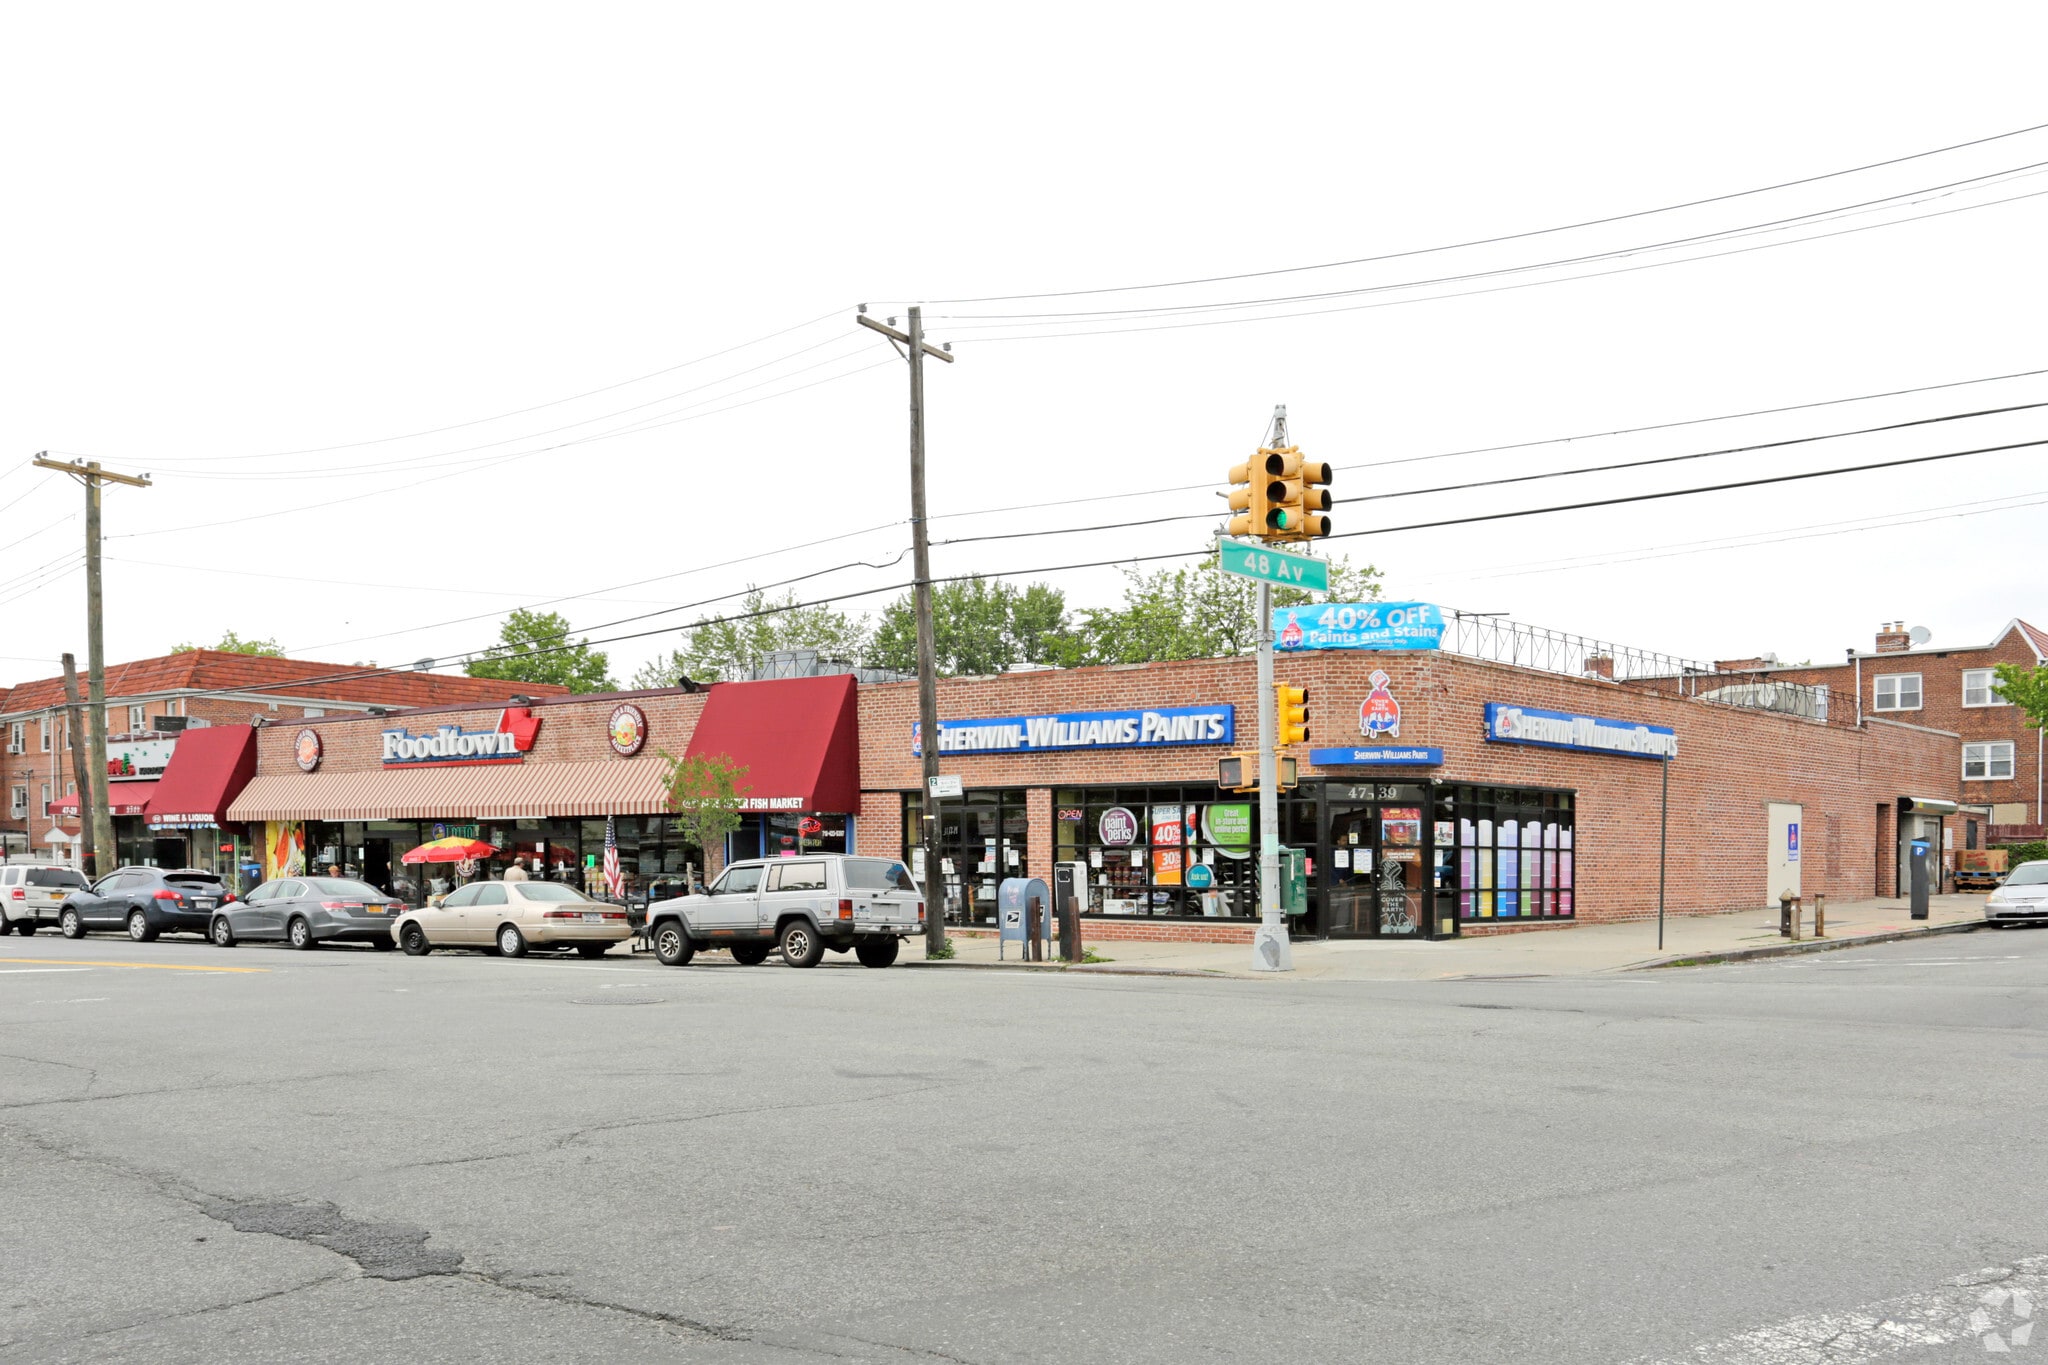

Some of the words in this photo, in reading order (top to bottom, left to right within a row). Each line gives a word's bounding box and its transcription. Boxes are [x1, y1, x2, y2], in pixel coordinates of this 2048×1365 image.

[1244, 552, 1270, 575] 48
[1277, 559, 1303, 581] Av
[1318, 607, 1381, 630] 40%
[1386, 606, 1430, 628] OFF
[1309, 630, 1357, 643] Paints
[1361, 628, 1389, 640] and
[1394, 624, 1438, 638] Stains
[1142, 711, 1224, 744] PAINTS
[1509, 708, 1637, 749] SHERWIN-WILLIAMS
[1634, 726, 1678, 757] PAINTS
[381, 727, 519, 760] Foodtown
[1354, 750, 1411, 760] SHERWIN-WILLIAMS
[750, 799, 769, 809] FISH
[770, 798, 804, 809] MARKET
[162, 814, 180, 822] WINE
[181, 814, 187, 822] &
[188, 813, 215, 822] LIQUOR
[1058, 810, 1083, 820] OPEN
[1105, 815, 1127, 830] paint
[1107, 828, 1132, 842] perks
[1155, 823, 1181, 843] 40%
